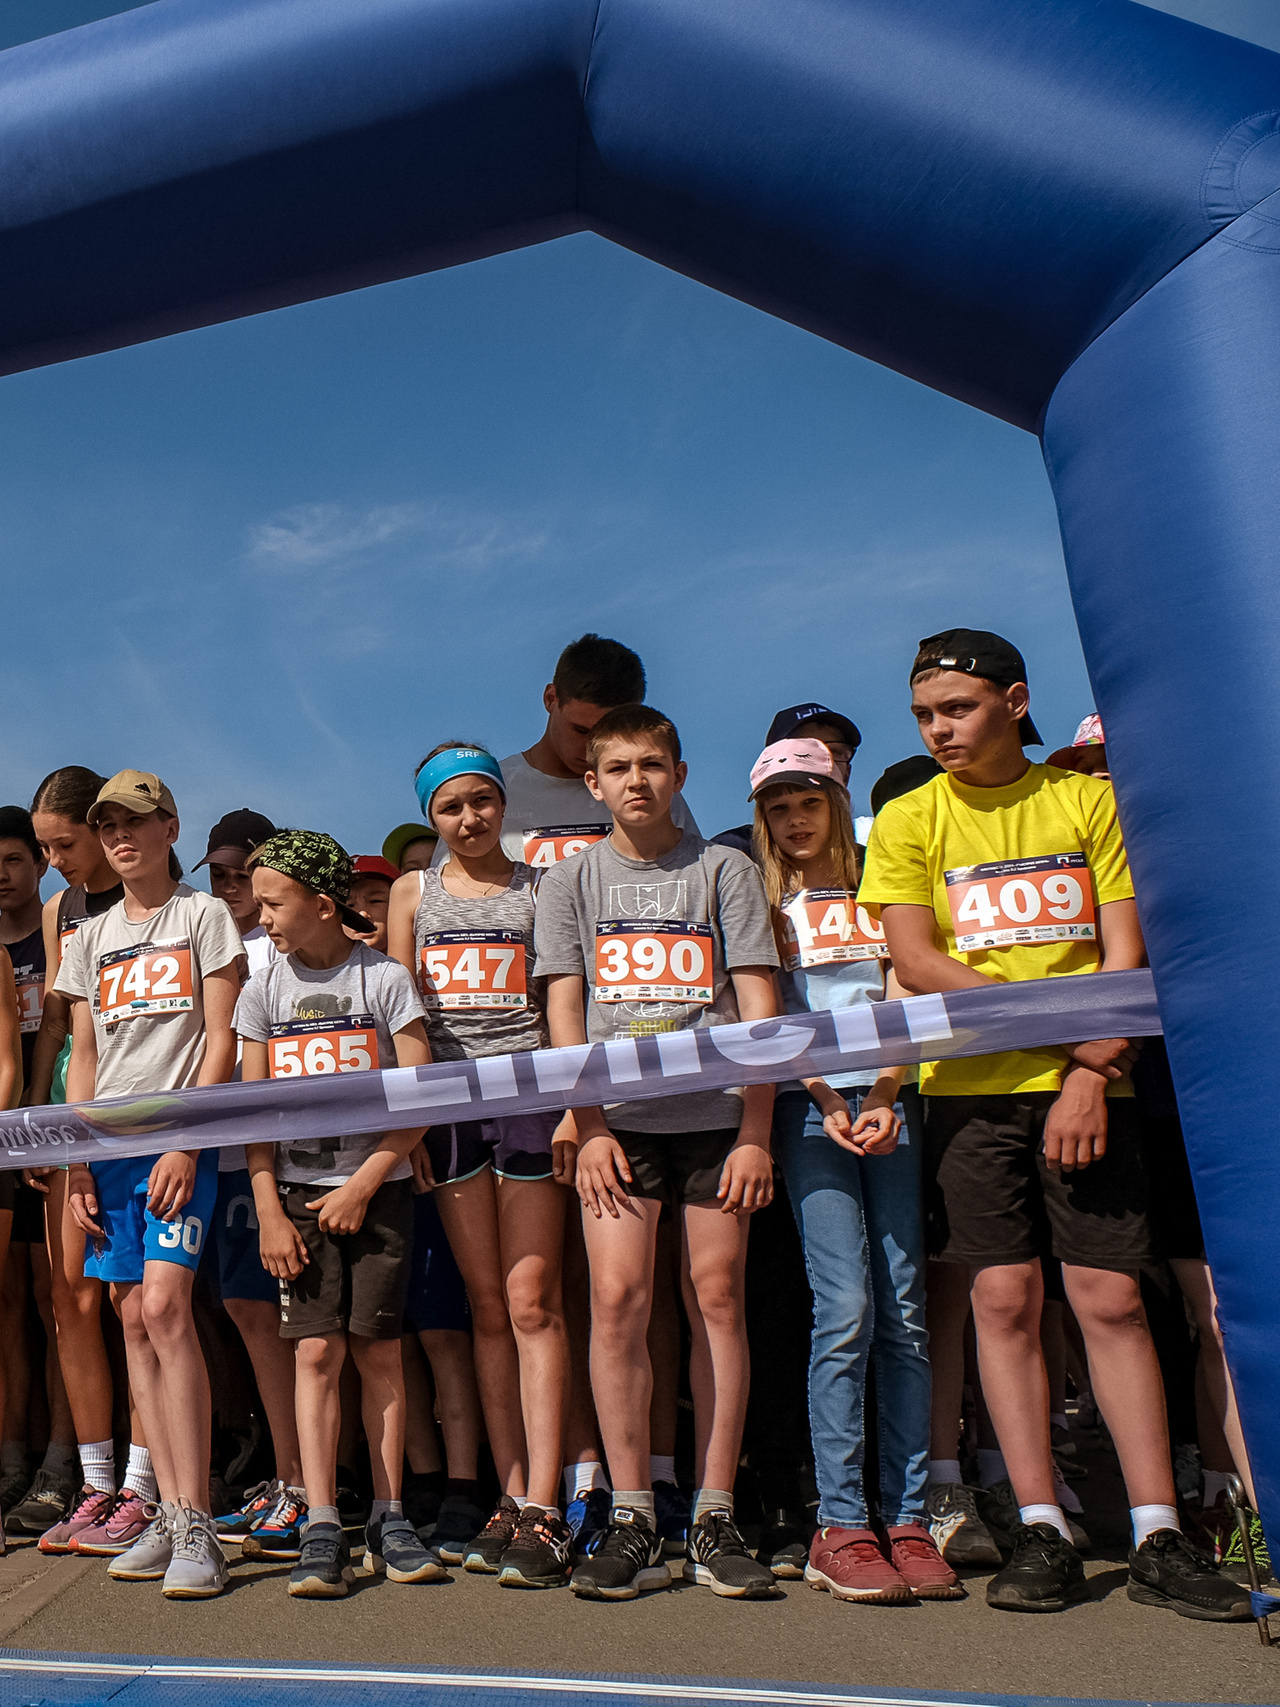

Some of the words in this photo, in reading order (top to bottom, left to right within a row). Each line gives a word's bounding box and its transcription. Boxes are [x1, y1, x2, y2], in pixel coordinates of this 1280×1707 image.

[957, 874, 1084, 928] 409
[103, 956, 182, 1007] 742
[425, 947, 516, 991] 547
[598, 937, 705, 982] 390
[274, 1034, 372, 1079] 565
[158, 1212, 203, 1255] 30
